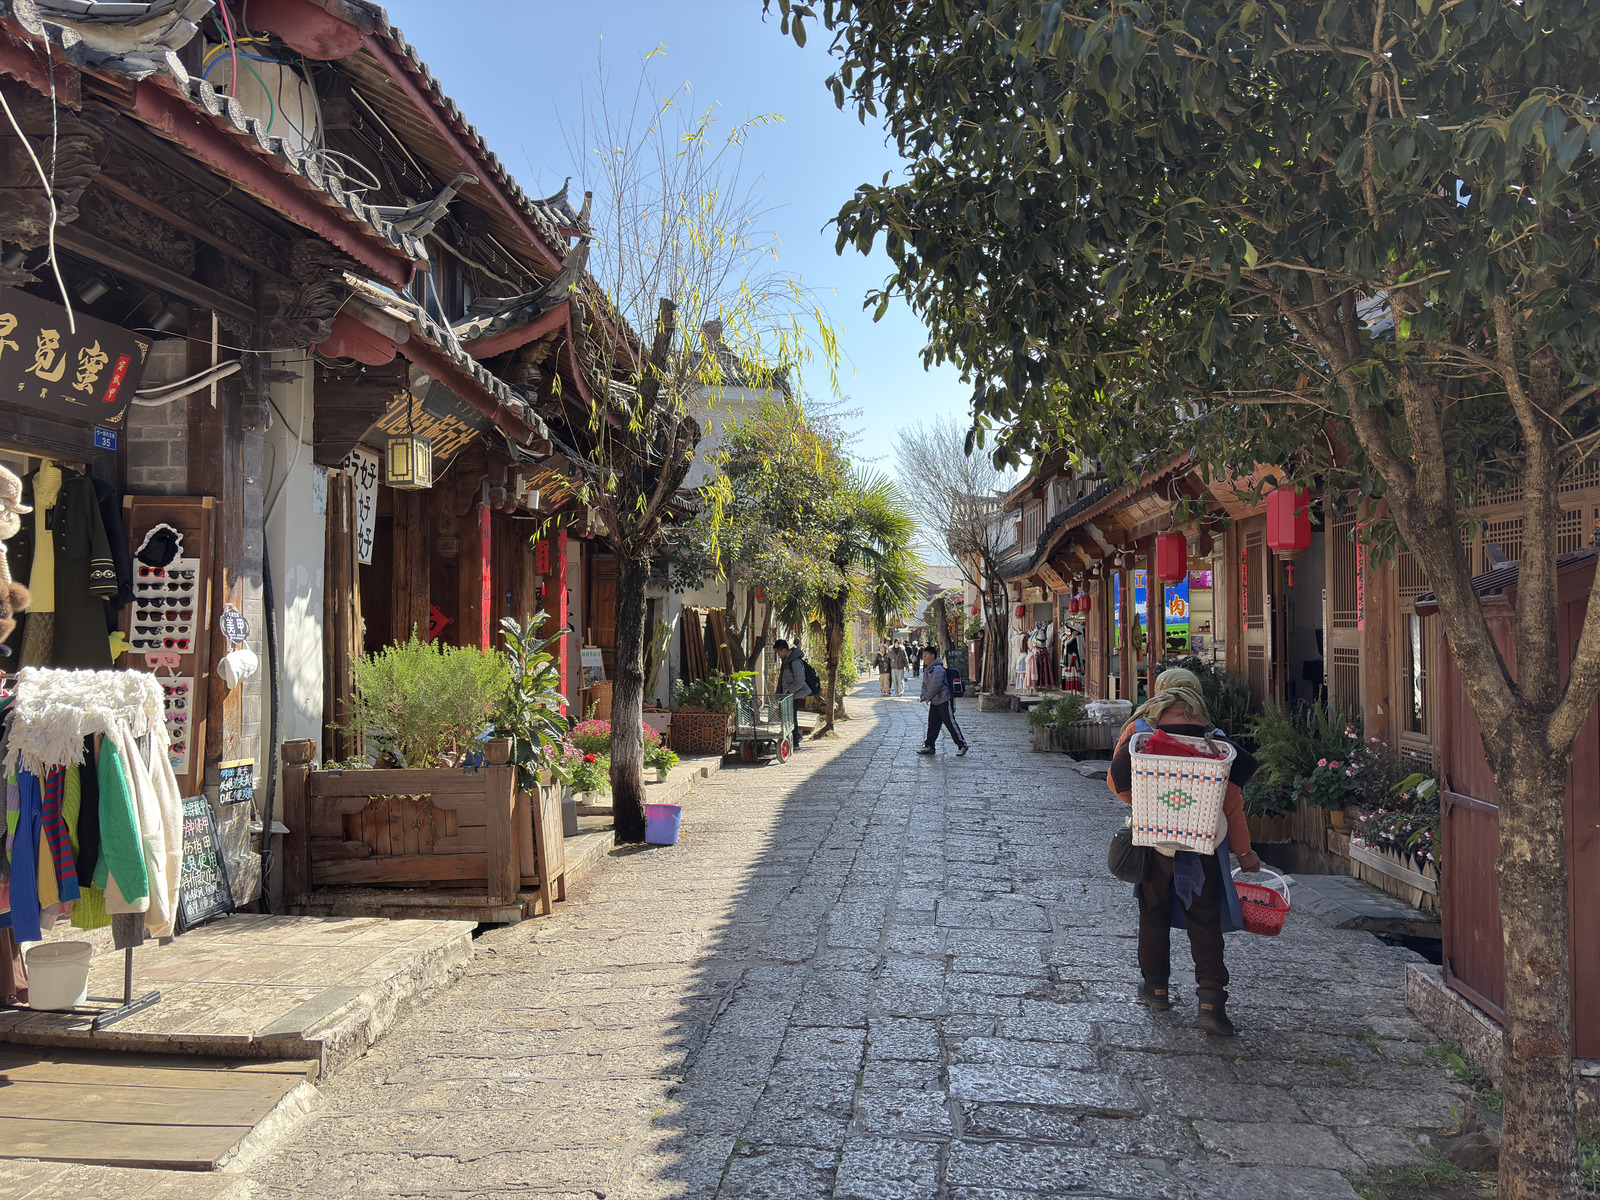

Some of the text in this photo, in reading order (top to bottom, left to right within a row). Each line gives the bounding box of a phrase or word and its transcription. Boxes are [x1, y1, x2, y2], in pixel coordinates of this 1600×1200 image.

[101, 437, 111, 447] 35
[357, 458, 377, 560] 好好好
[226, 617, 244, 634] 美甲
